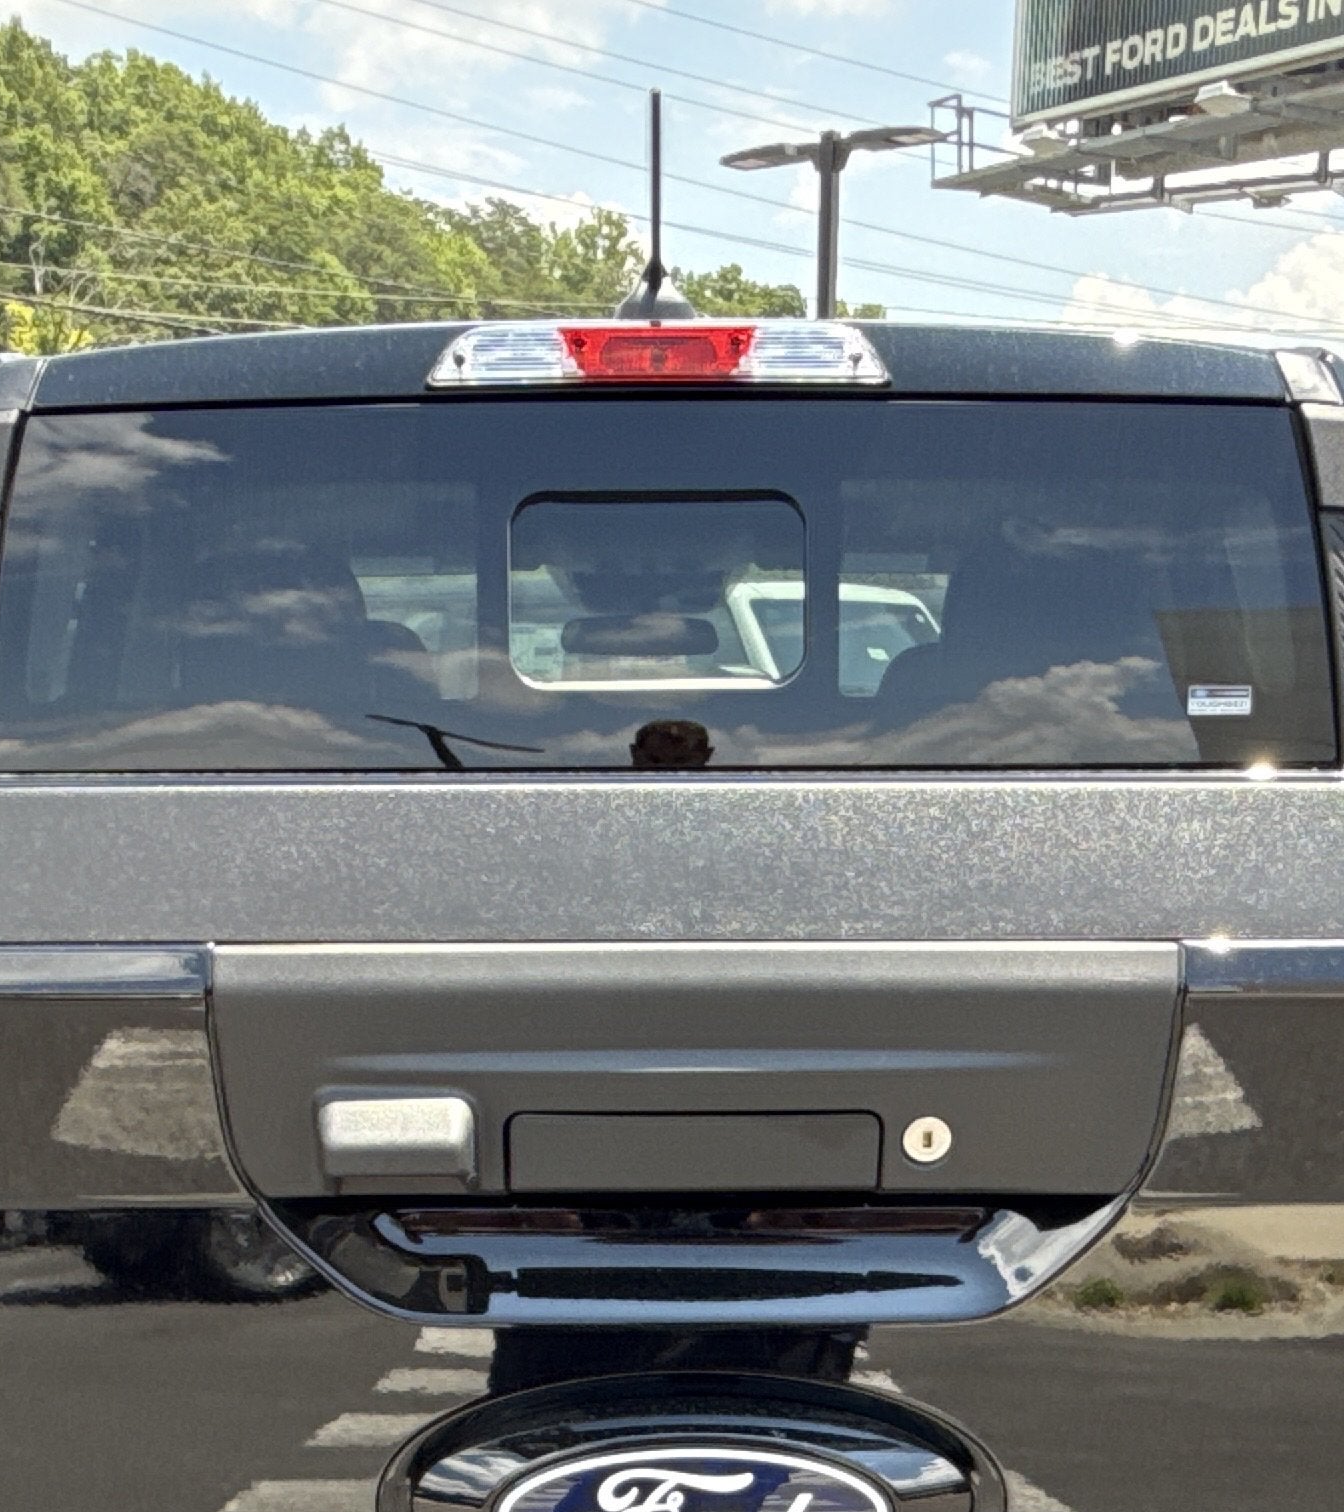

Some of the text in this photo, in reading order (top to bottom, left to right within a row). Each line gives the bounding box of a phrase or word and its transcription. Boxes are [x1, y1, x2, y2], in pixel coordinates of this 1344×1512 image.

[1030, 44, 1101, 95] BEST
[1105, 22, 1188, 76] FORD
[1192, 0, 1300, 52] DEALS
